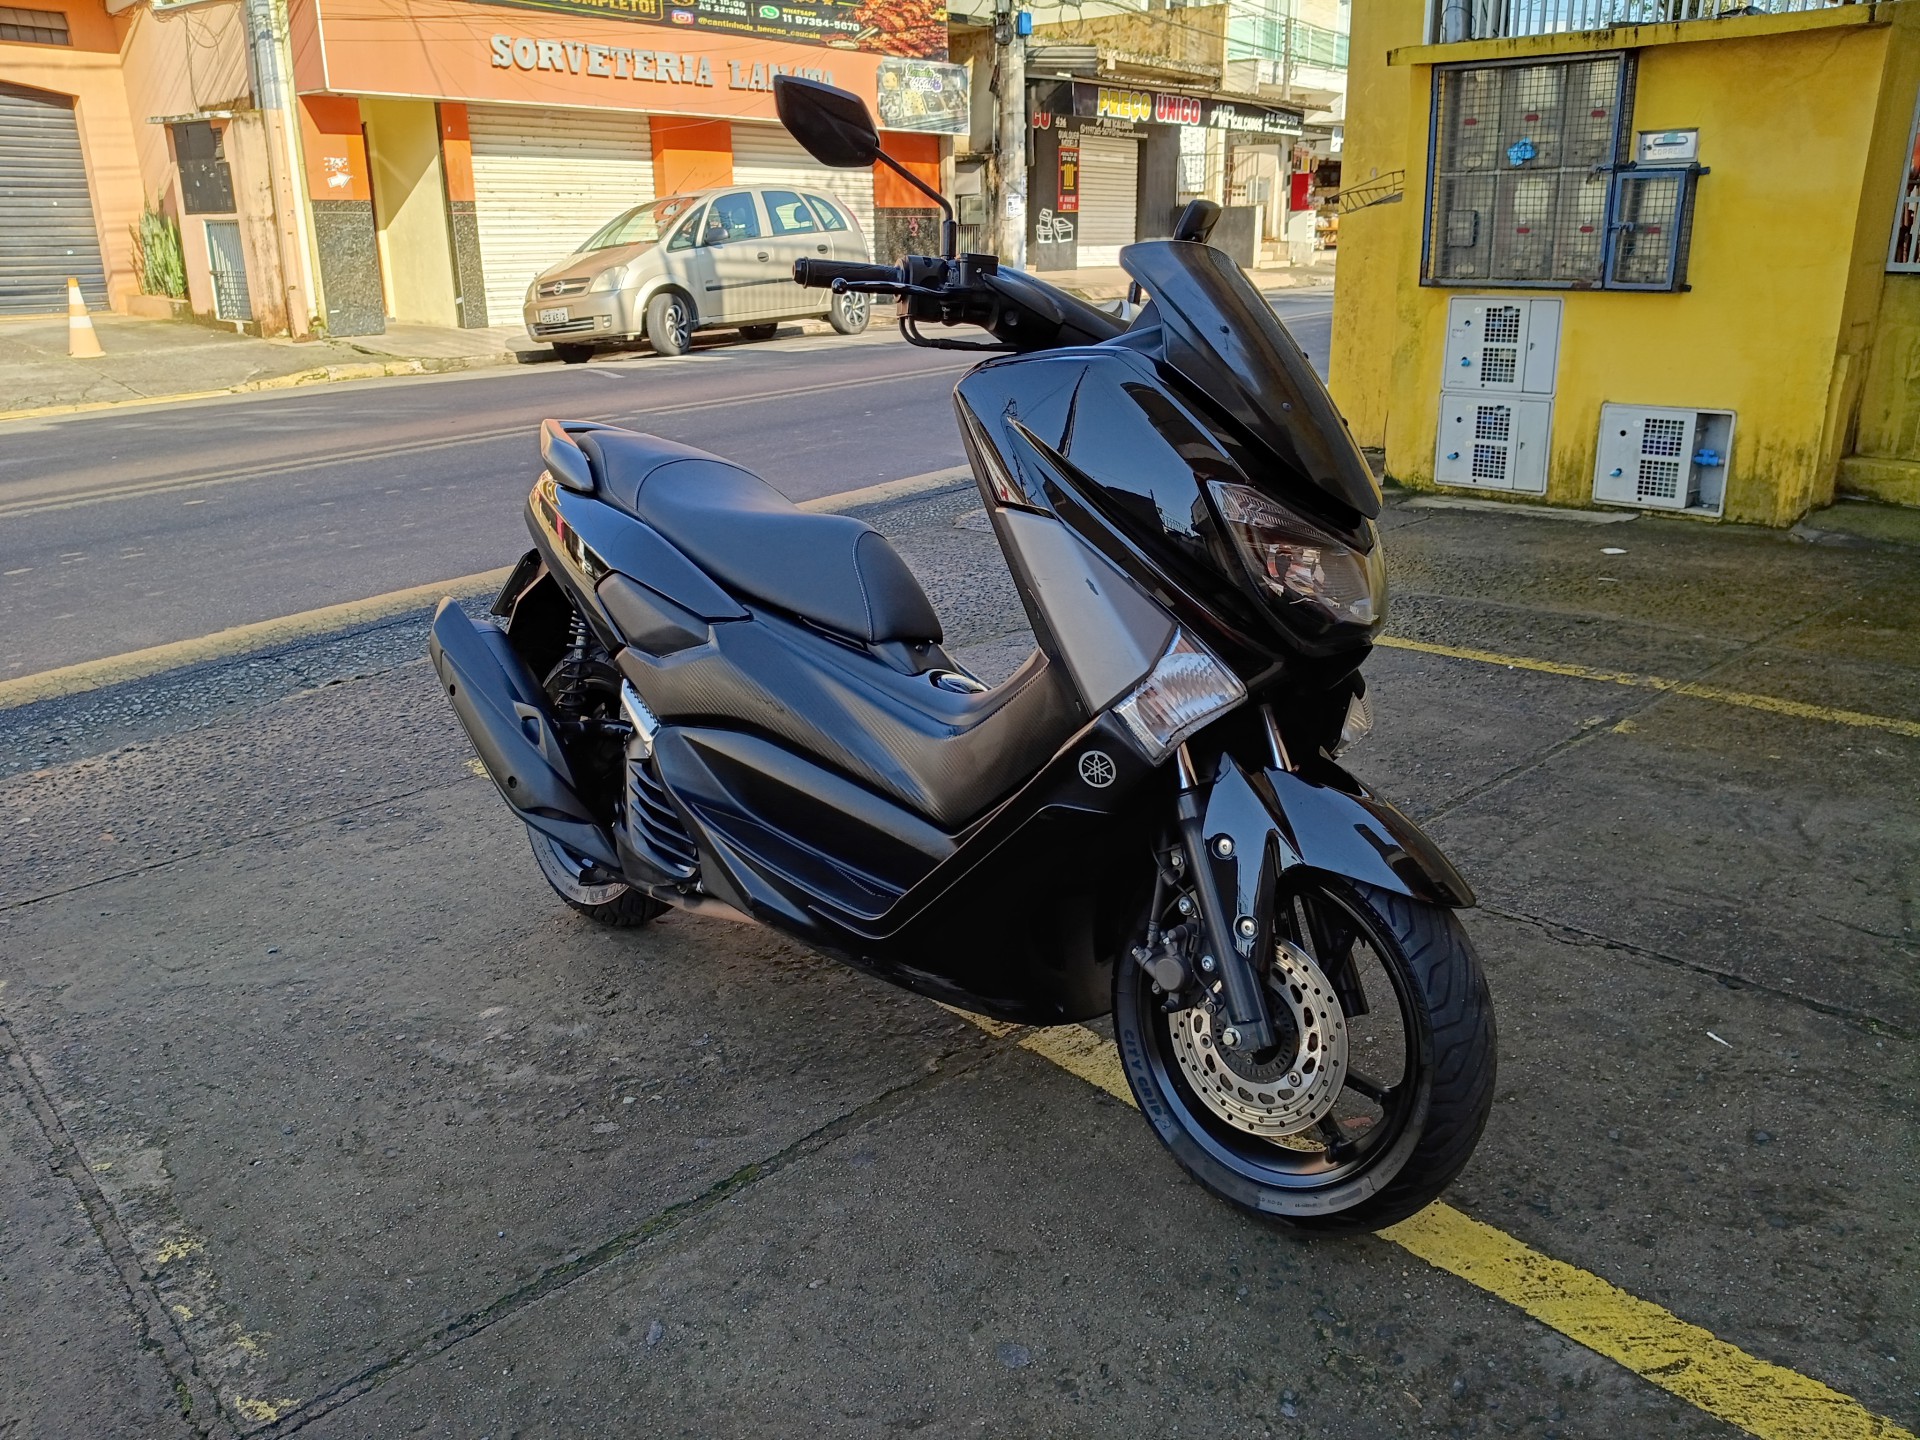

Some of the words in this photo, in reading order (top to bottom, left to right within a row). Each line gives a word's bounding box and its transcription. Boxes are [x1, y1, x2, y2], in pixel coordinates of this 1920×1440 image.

[561, 0, 656, 14] PLETO!
[782, 7, 817, 17] WHATSAPP
[782, 14, 793, 23] 11
[490, 34, 713, 87] SORVETERIA
[1097, 87, 1151, 123] PREÇO
[1155, 93, 1201, 125] ÚNICO
